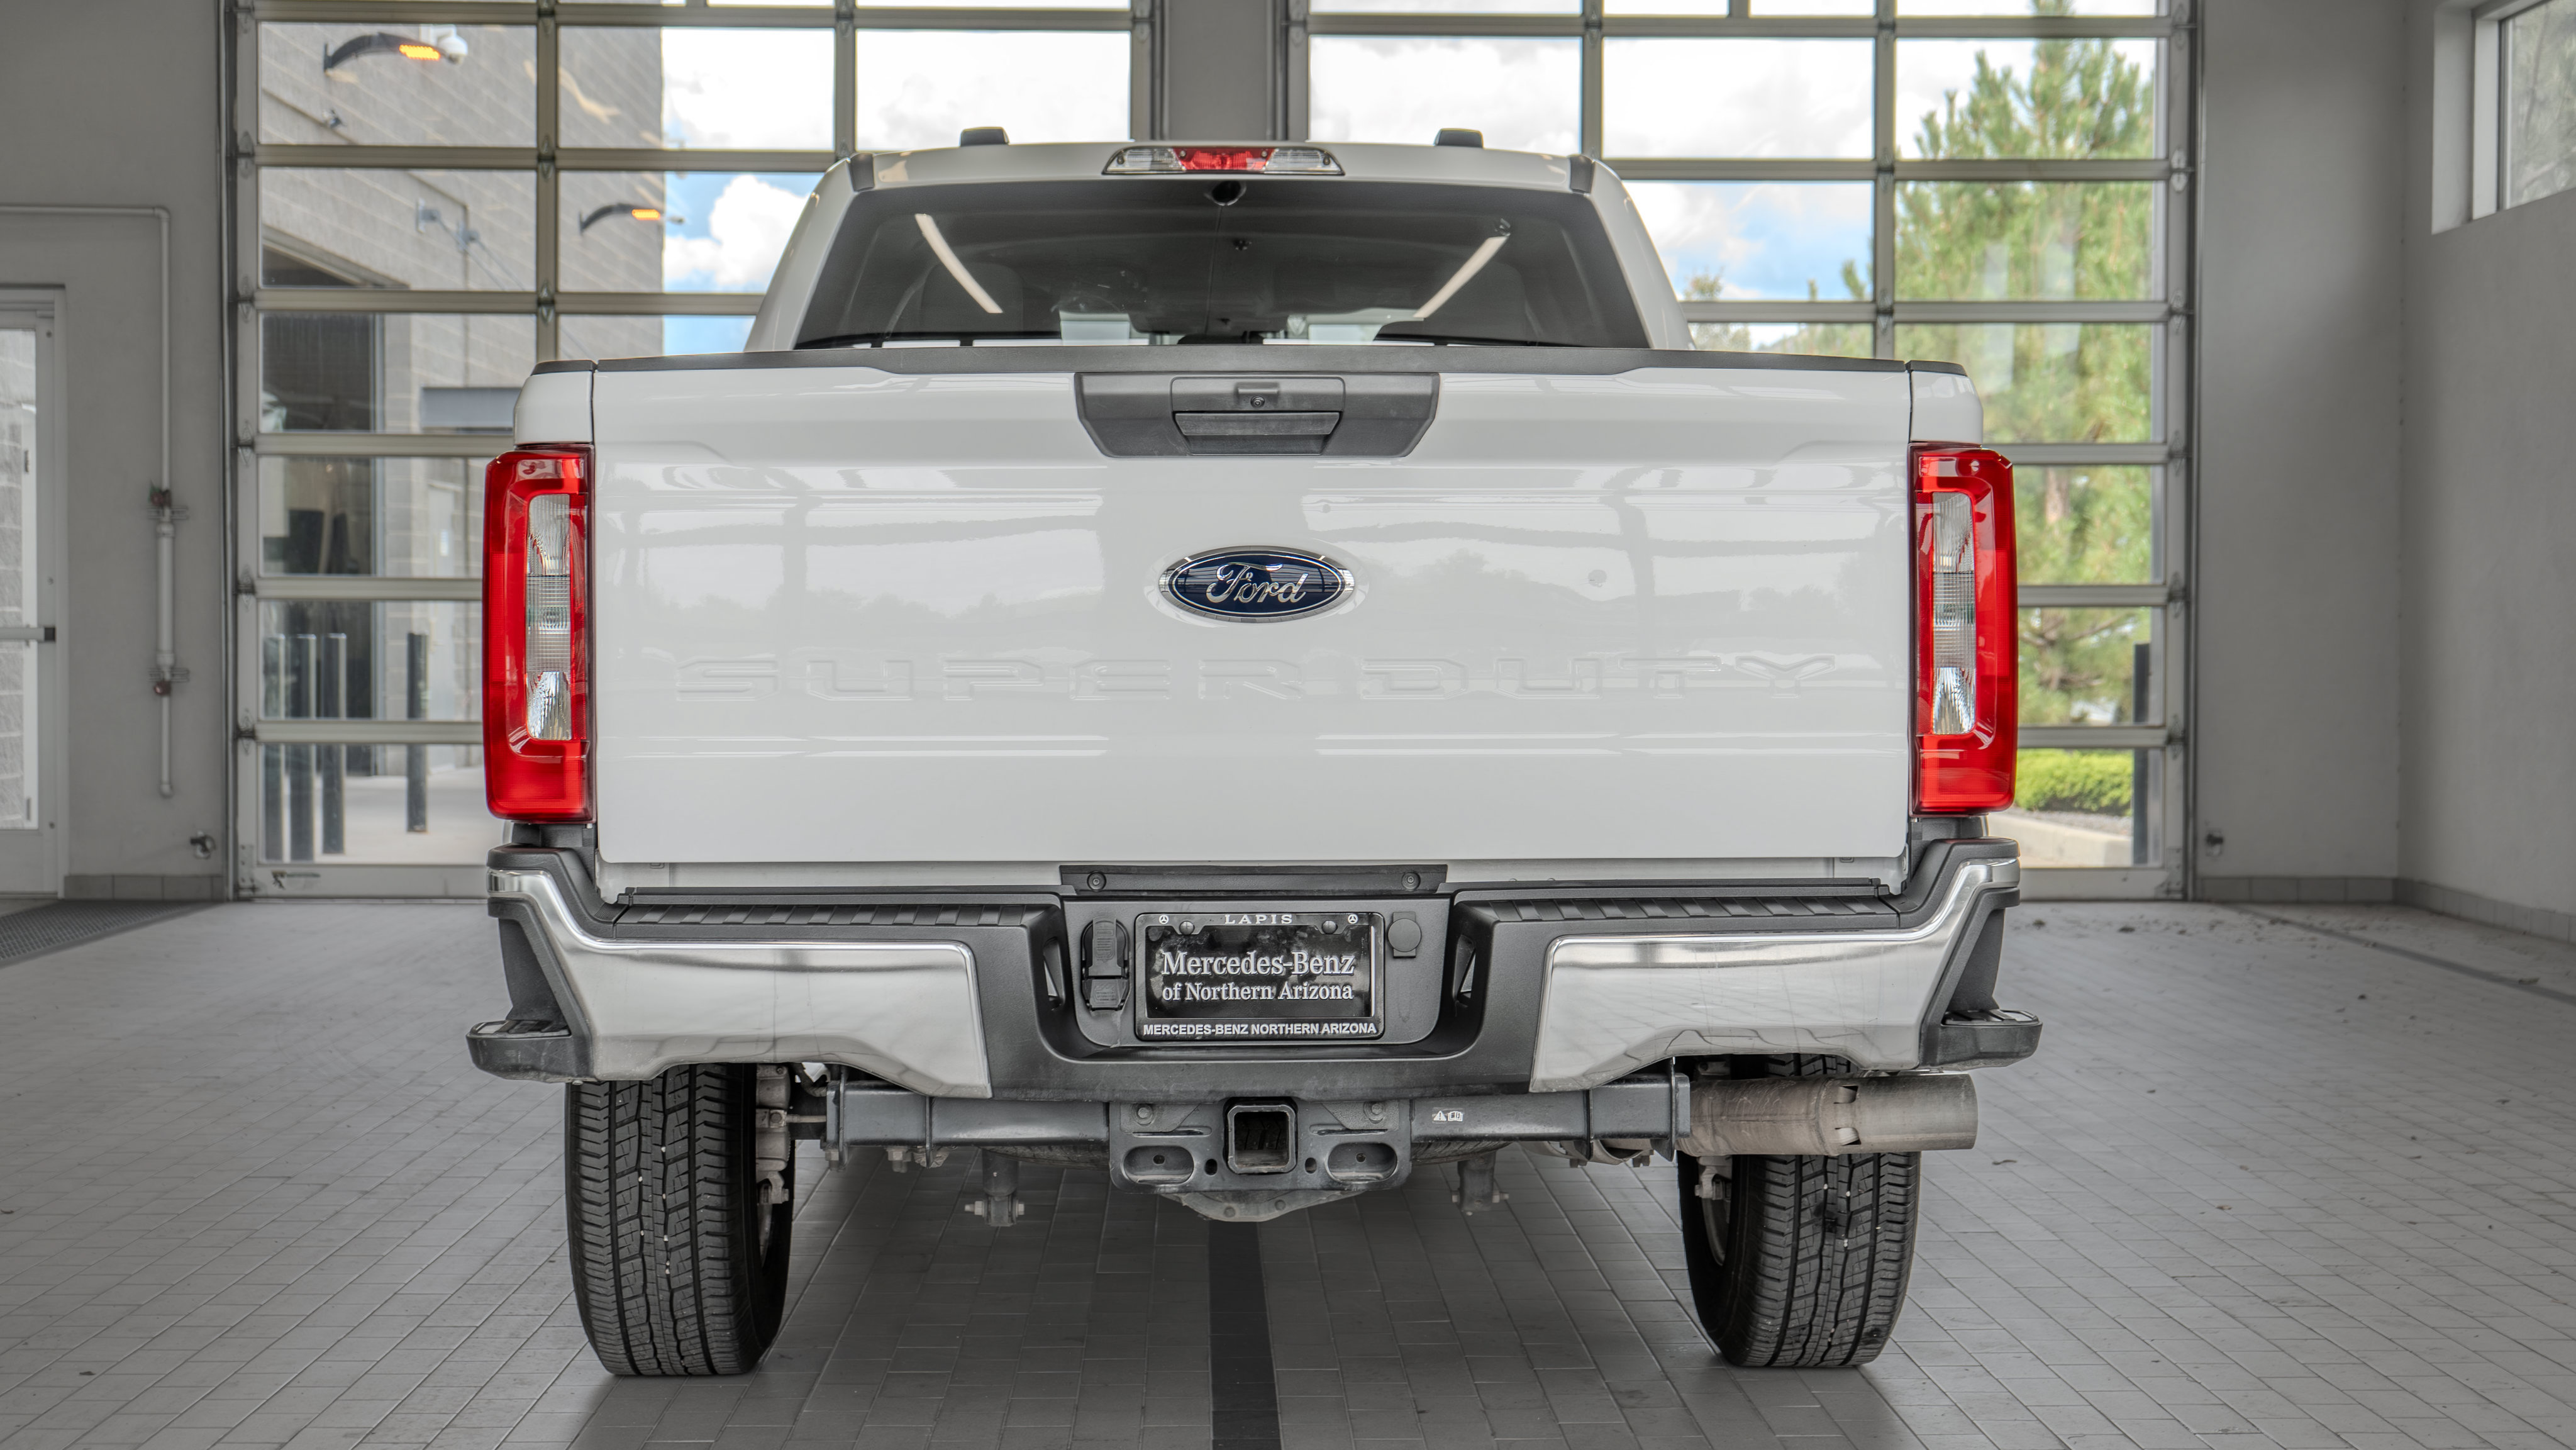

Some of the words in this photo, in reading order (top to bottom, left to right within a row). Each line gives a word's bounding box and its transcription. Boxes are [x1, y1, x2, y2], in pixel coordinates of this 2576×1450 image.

[1206, 562, 1309, 603] Ford
[675, 657, 1304, 701] SUPER
[1361, 655, 1836, 700] DUTY
[1224, 914, 1294, 925] LAPIS
[1162, 951, 1355, 976] Mercedes-Benz
[1162, 983, 1182, 1001] of
[1185, 983, 1275, 1001] Northern
[1277, 981, 1354, 1000] Arizona
[1143, 1023, 1249, 1035] MERCEDES-BENZ
[1250, 1023, 1319, 1035] NORTHERN
[1322, 1023, 1377, 1035] ARIZONA
